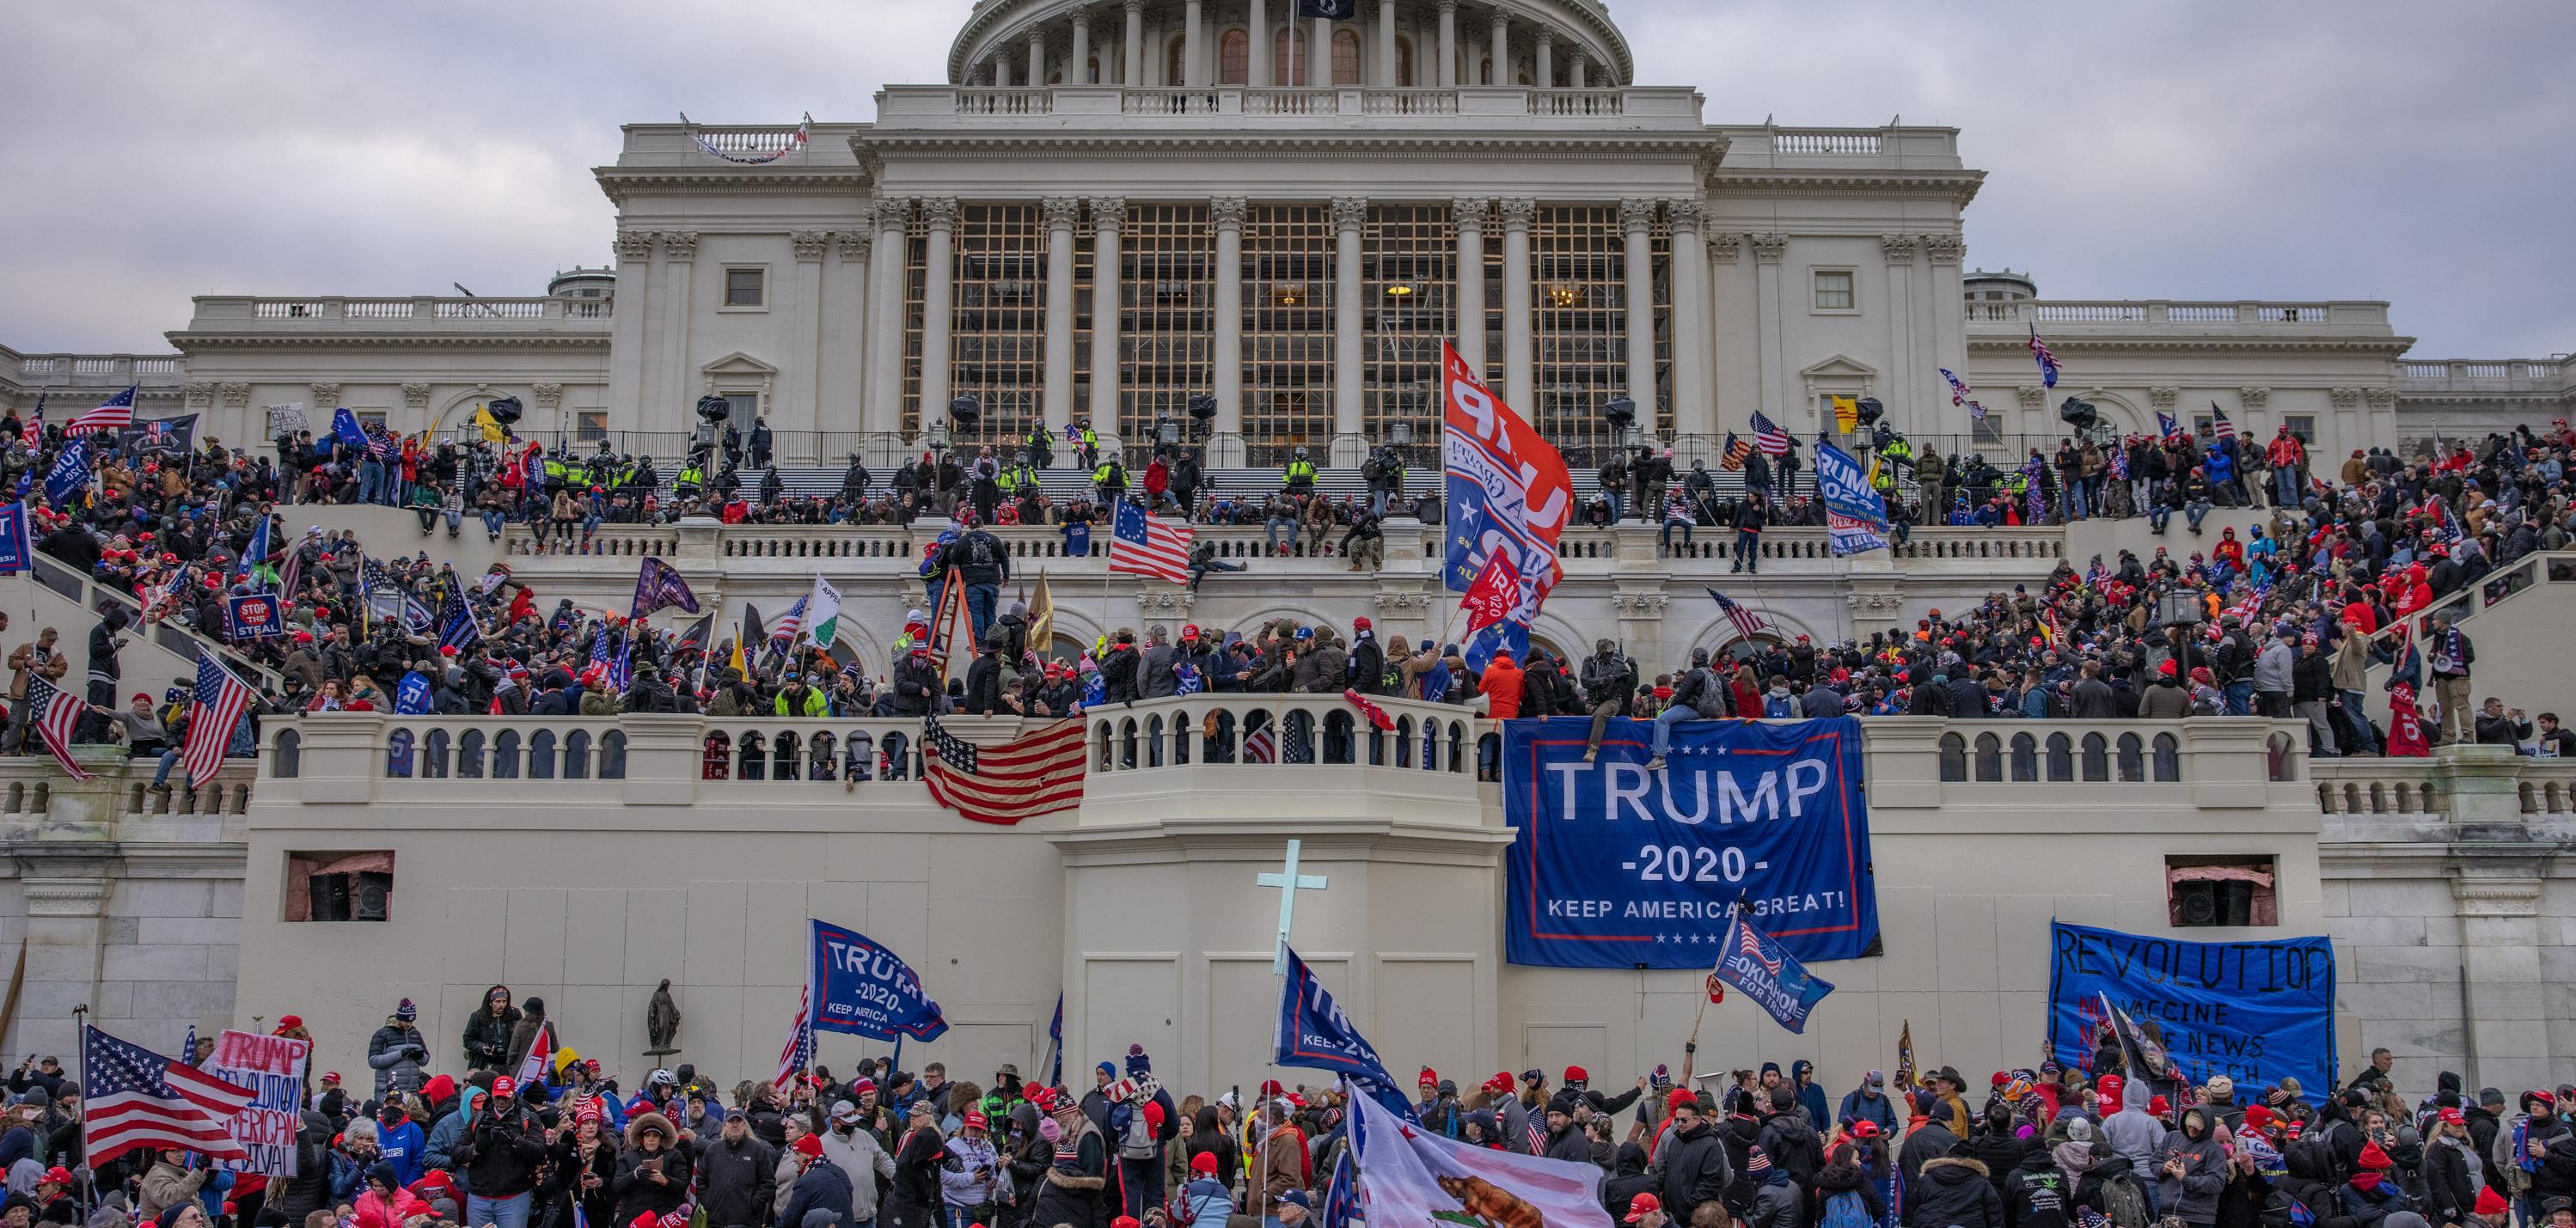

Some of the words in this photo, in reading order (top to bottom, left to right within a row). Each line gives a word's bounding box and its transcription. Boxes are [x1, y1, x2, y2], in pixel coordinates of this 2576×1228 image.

[822, 587, 841, 605] APPEA
[242, 603, 266, 615] STOP
[238, 624, 278, 636] STEAL
[1546, 758, 1827, 825] TRUMP
[1622, 845, 1768, 883] -2020-
[1549, 899, 1613, 918] KEEP
[1625, 900, 1742, 919] AMERICA
[1754, 890, 1845, 917] GREAT!
[855, 982, 903, 1013] -2020-
[1736, 956, 1800, 1015] OKLAHOM
[1740, 977, 1765, 999] FOR
[828, 1002, 852, 1015] KEEP
[854, 1006, 888, 1023] AMERICA
[2120, 999, 2229, 1026] VACCINE
[1304, 1034, 1337, 1049] KEE
[2079, 1025, 2095, 1047] N
[2188, 1031, 2266, 1059] NEWS
[222, 1030, 306, 1075] TRUMP
[2078, 1051, 2092, 1072] N
[2189, 1059, 2260, 1084] TECH
